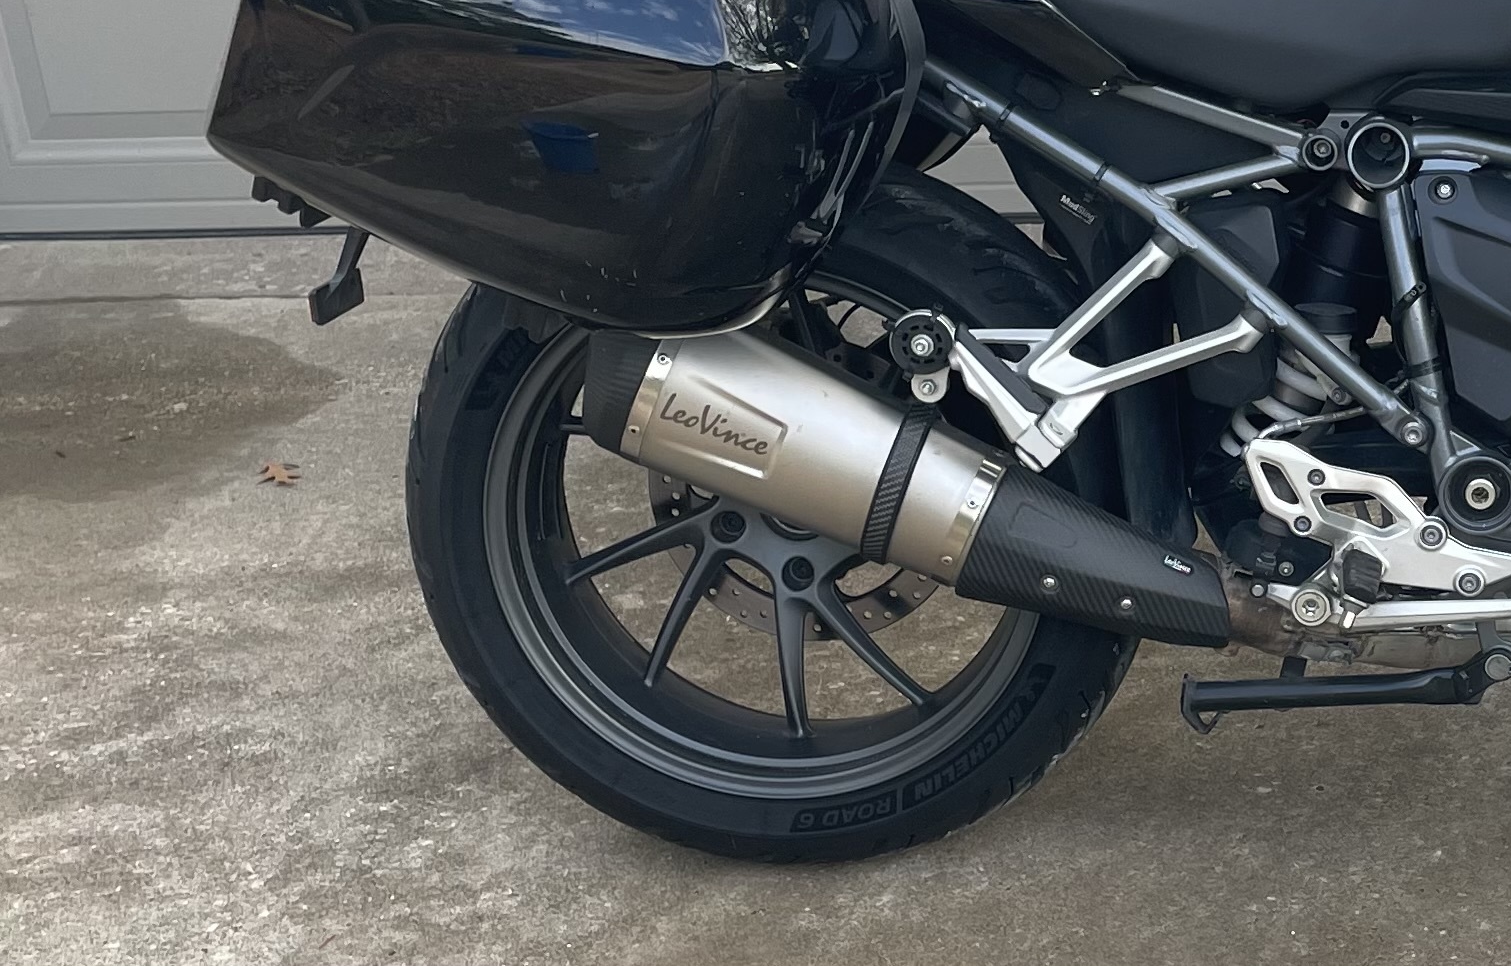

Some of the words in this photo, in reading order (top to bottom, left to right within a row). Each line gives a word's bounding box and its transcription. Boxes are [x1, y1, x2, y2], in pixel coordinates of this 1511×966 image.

[659, 392, 769, 455] LeoVince
[913, 700, 1026, 801] MICHELIN
[798, 812, 816, 829] 6
[821, 795, 892, 827] ROAD
